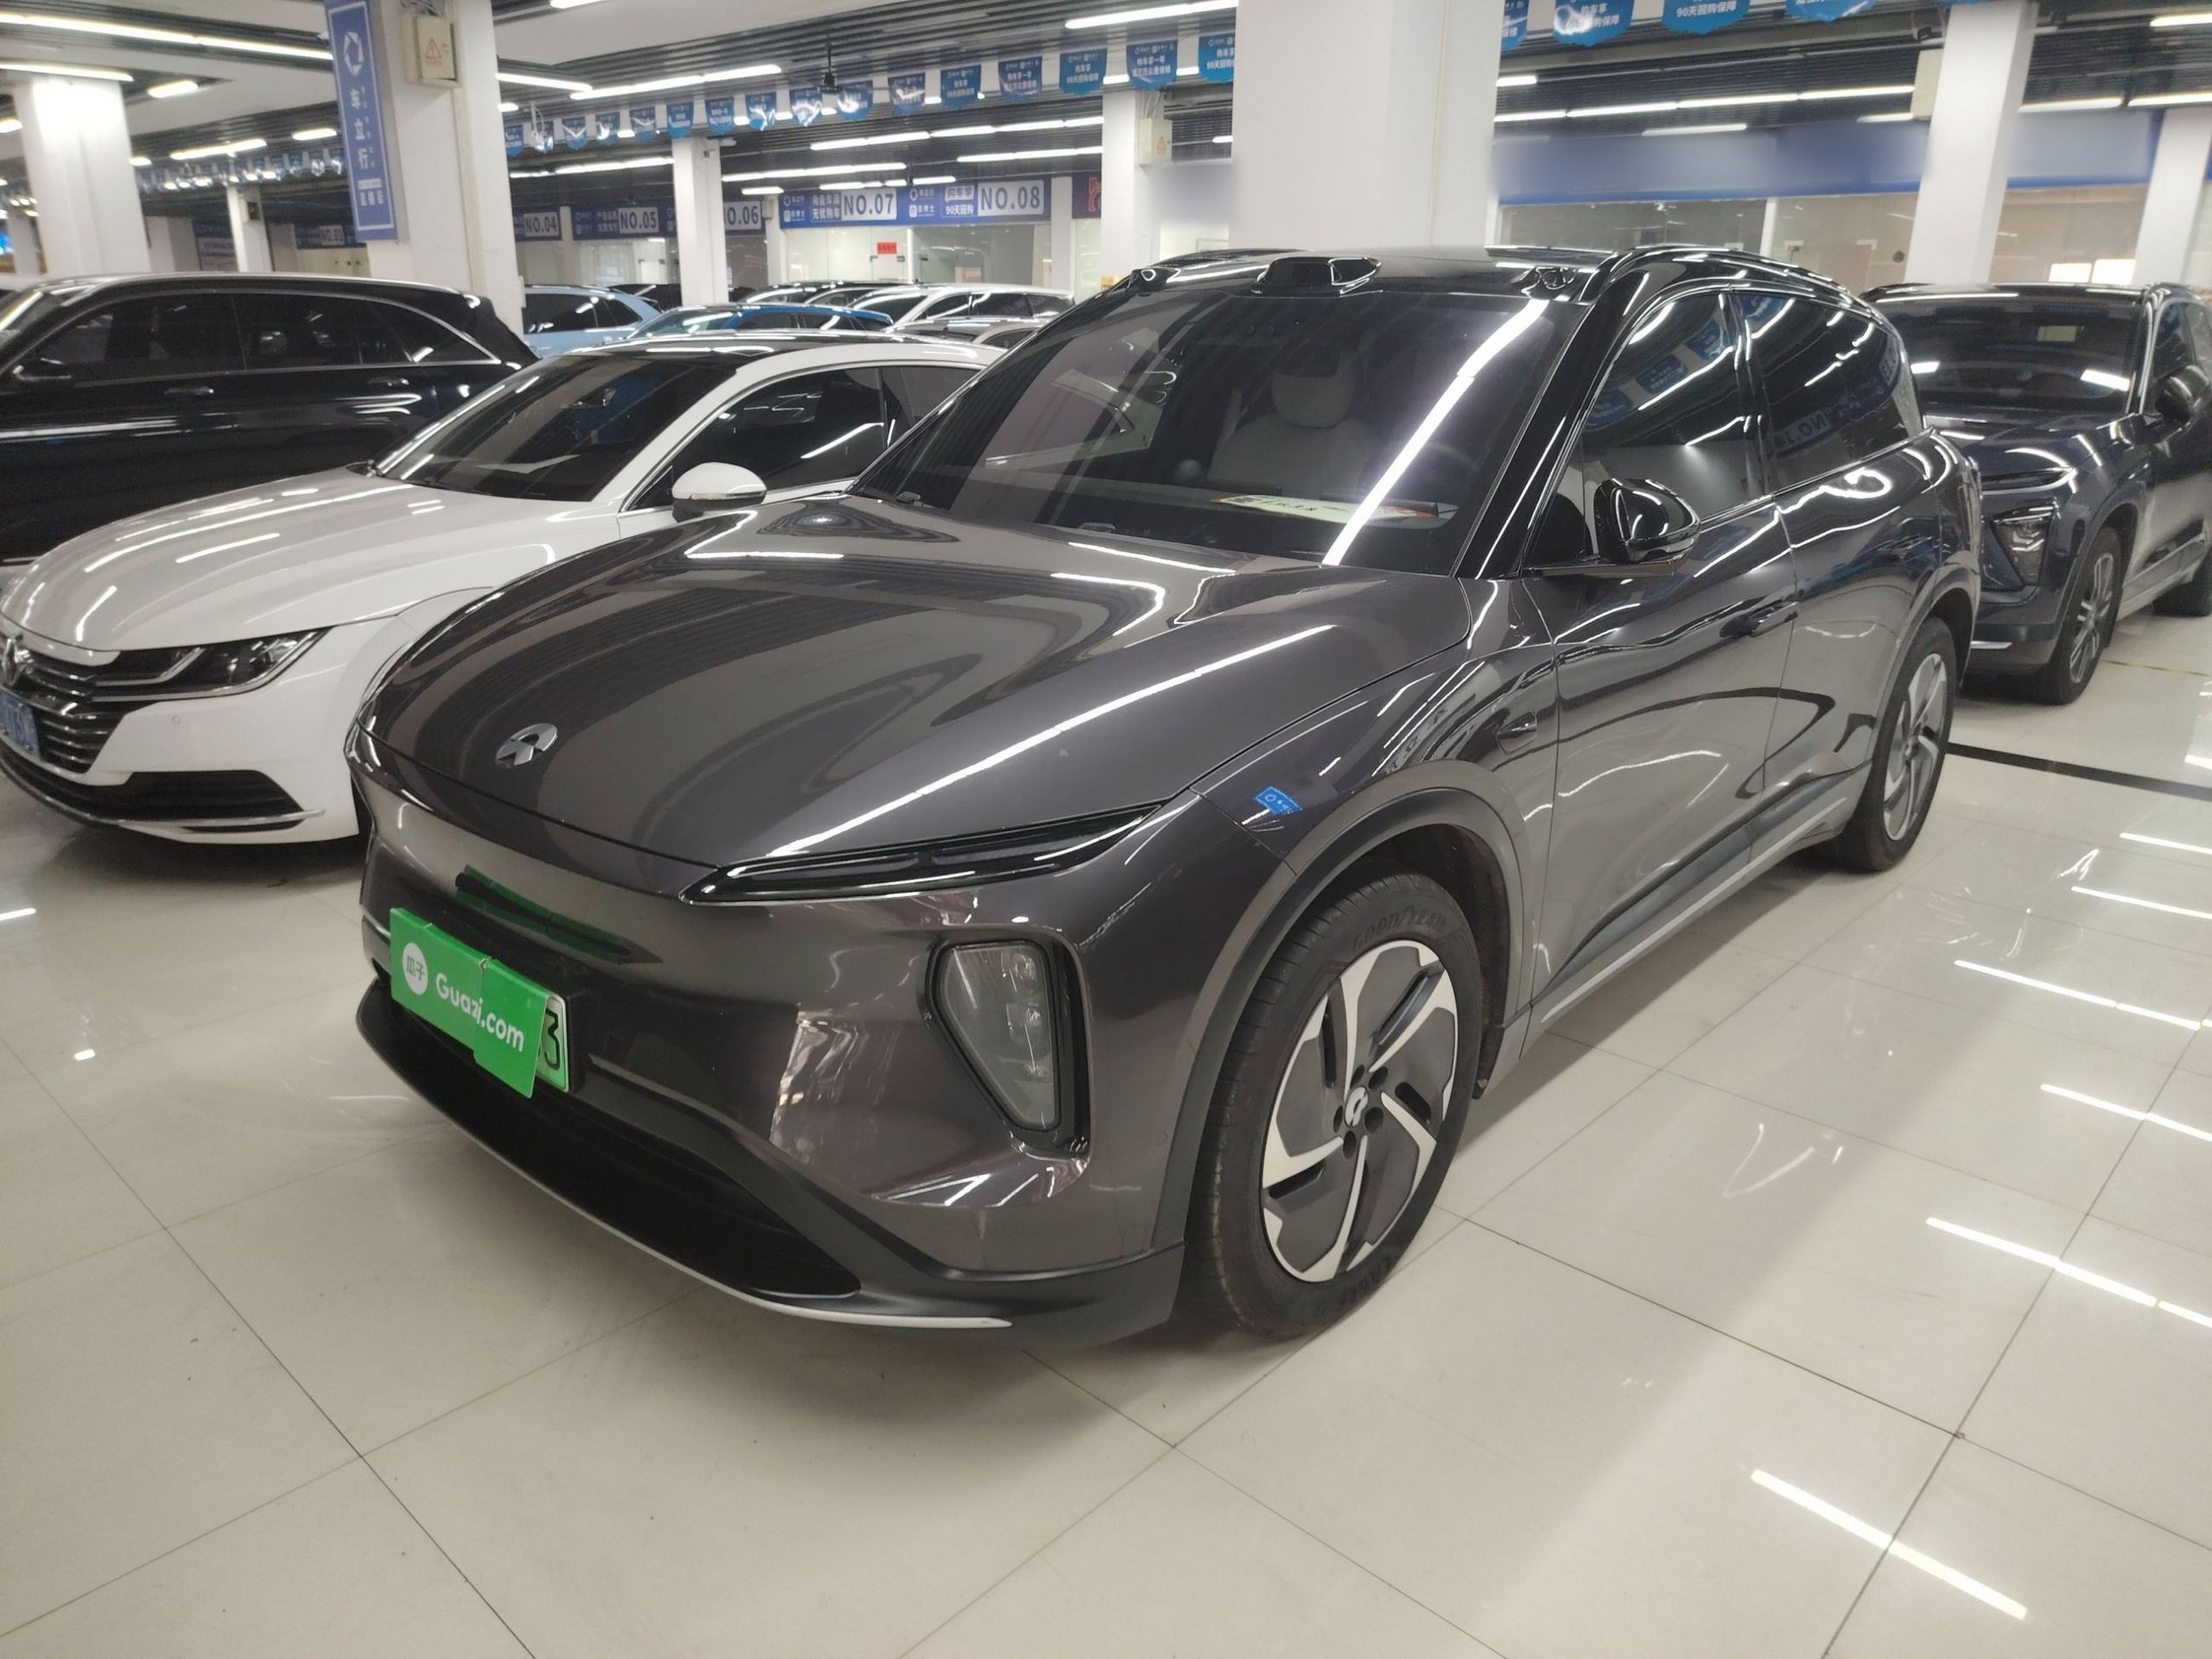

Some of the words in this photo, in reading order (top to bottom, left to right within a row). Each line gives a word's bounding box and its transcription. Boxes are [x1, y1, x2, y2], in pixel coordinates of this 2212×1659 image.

[1676, 1, 1736, 17] 90天回购保障
[843, 194, 894, 216] NO.07
[980, 185, 1040, 210] NO.08
[525, 215, 556, 233] NO.04
[620, 210, 657, 229] NO.05
[406, 955, 426, 981] 瓜子
[435, 972, 525, 1052] Guazi.com
